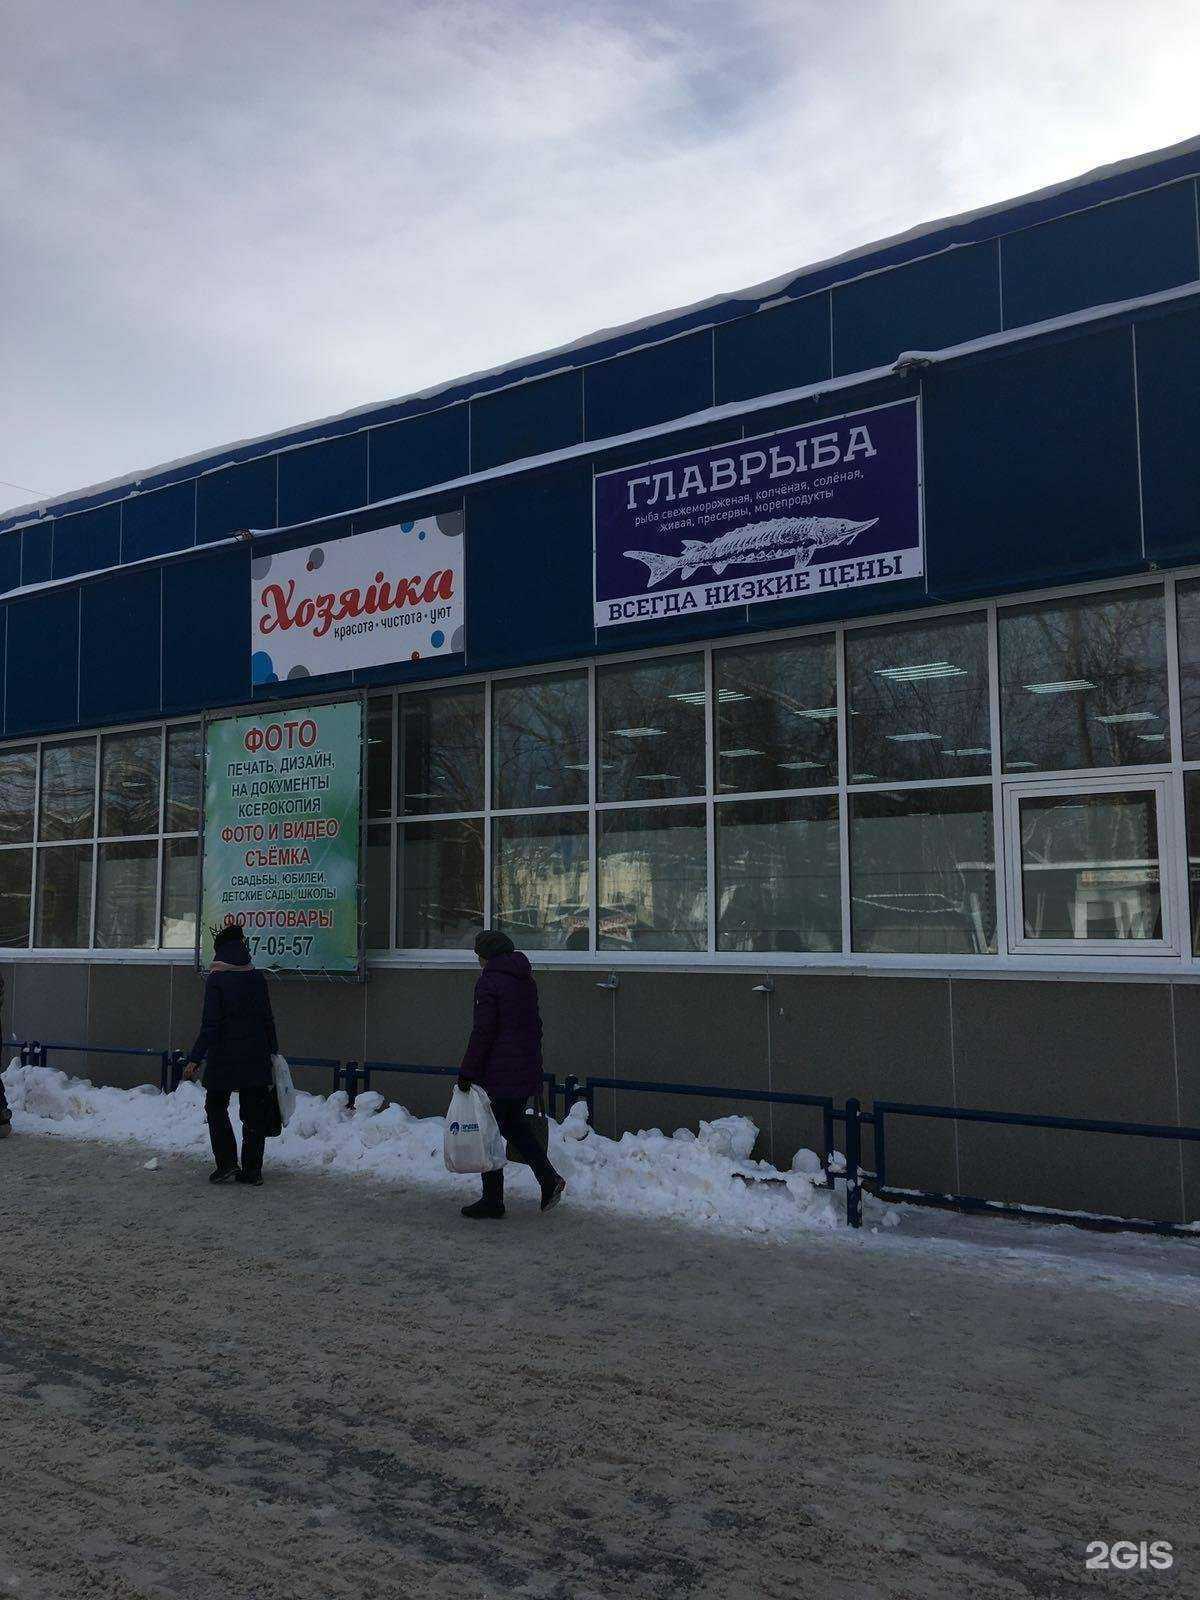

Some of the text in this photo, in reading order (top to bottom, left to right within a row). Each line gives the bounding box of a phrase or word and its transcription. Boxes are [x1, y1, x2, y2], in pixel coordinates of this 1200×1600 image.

[627, 425, 877, 509] ГЛАВРЫБА
[635, 511, 659, 527] рыба
[756, 481, 810, 500] копчёная,
[813, 469, 864, 488] солёная,
[660, 490, 834, 533] живая, пресервы, морепродукты
[608, 556, 902, 621] ВСЕГДА НИЗКИЕ ЦЕНЫ
[259, 569, 454, 637] Хозяйка
[334, 606, 452, 639] красота чистота уют
[244, 719, 317, 753] ФОТО
[227, 751, 335, 777] ПЕЧАТЬ, ДИЗАЙН,
[232, 776, 330, 798] НА ДОКУМЕНТЫ
[239, 798, 321, 818] КСЕРОКОПИЯ
[221, 819, 339, 842] ФОТО И ВИДЕО
[245, 846, 311, 867] СЪЁМКА
[231, 874, 279, 887] СВАДЬБЫ,
[222, 890, 264, 903] ДЕТСКИЕ
[299, 887, 336, 900] ШКОЛЫ
[224, 910, 332, 928] ФОТОТОВАРЫ
